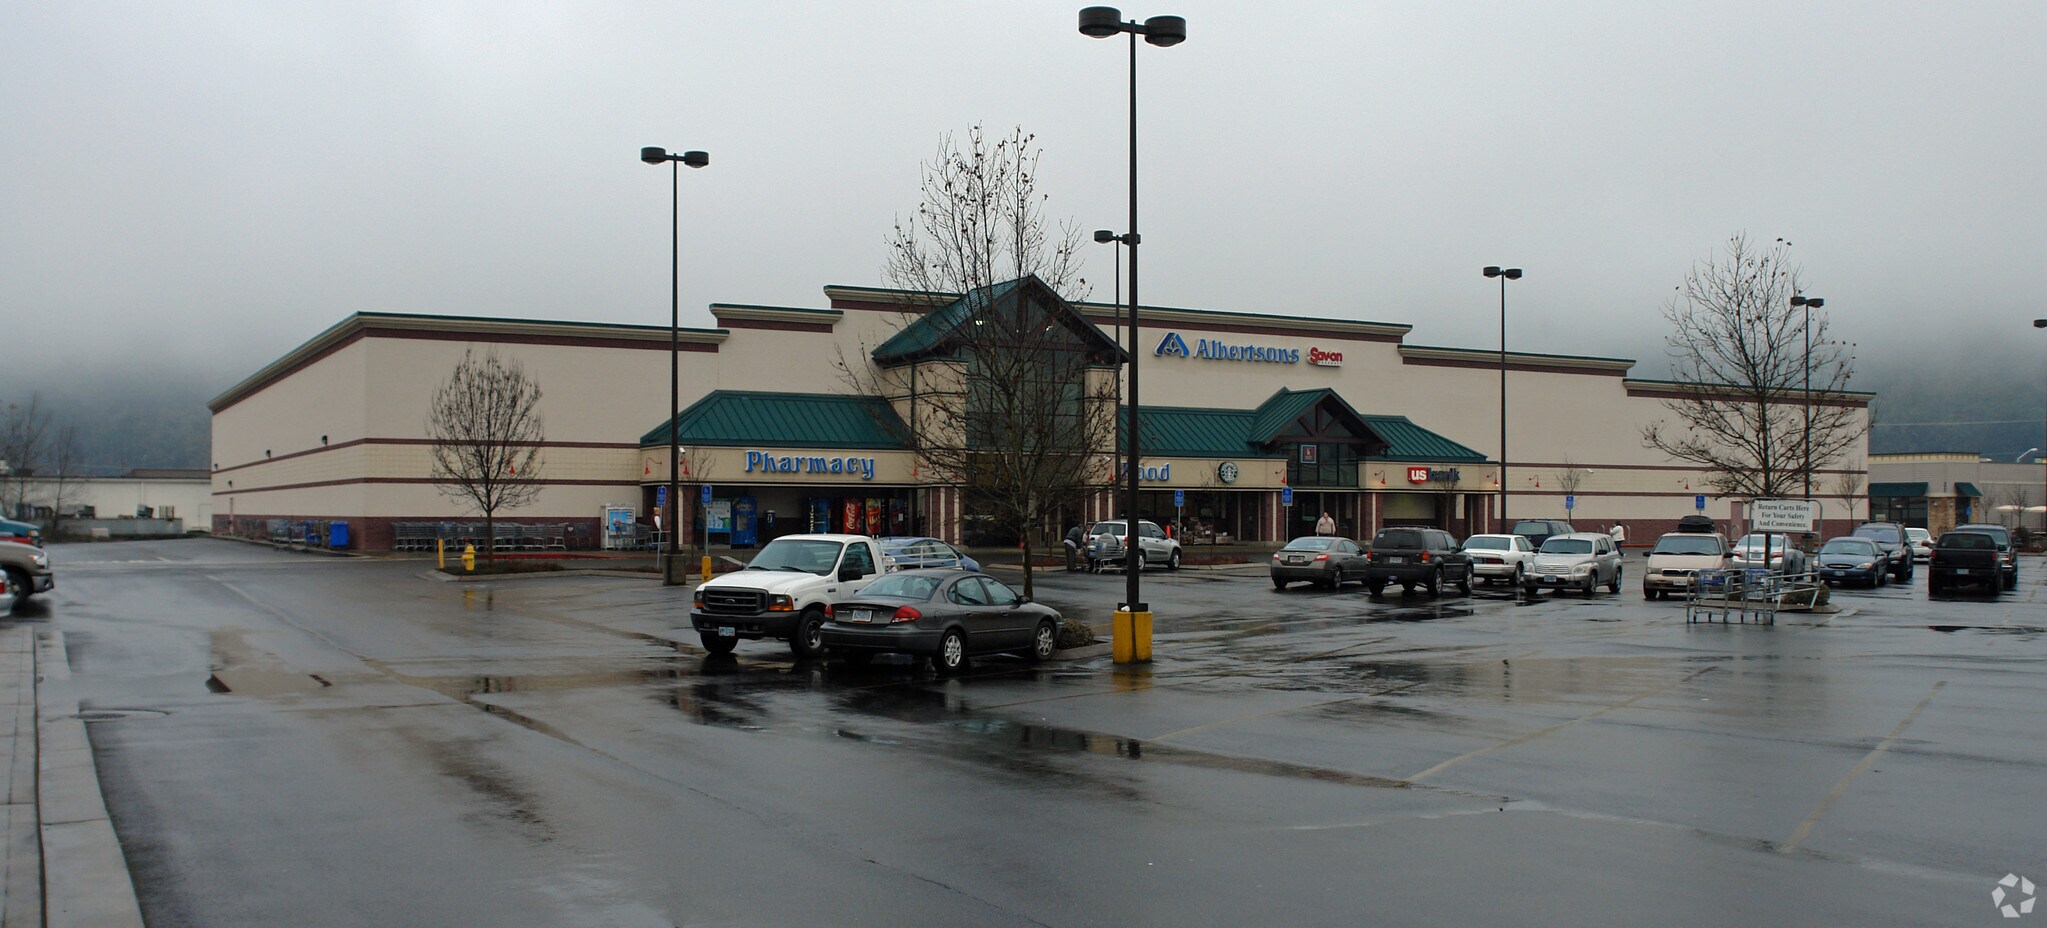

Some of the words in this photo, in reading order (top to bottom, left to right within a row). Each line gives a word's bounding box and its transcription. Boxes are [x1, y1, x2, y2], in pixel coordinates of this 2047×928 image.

[1193, 338, 1300, 363] Albertsons
[744, 449, 875, 480] Pharmacy
[1771, 520, 1808, 528] Convenience.
